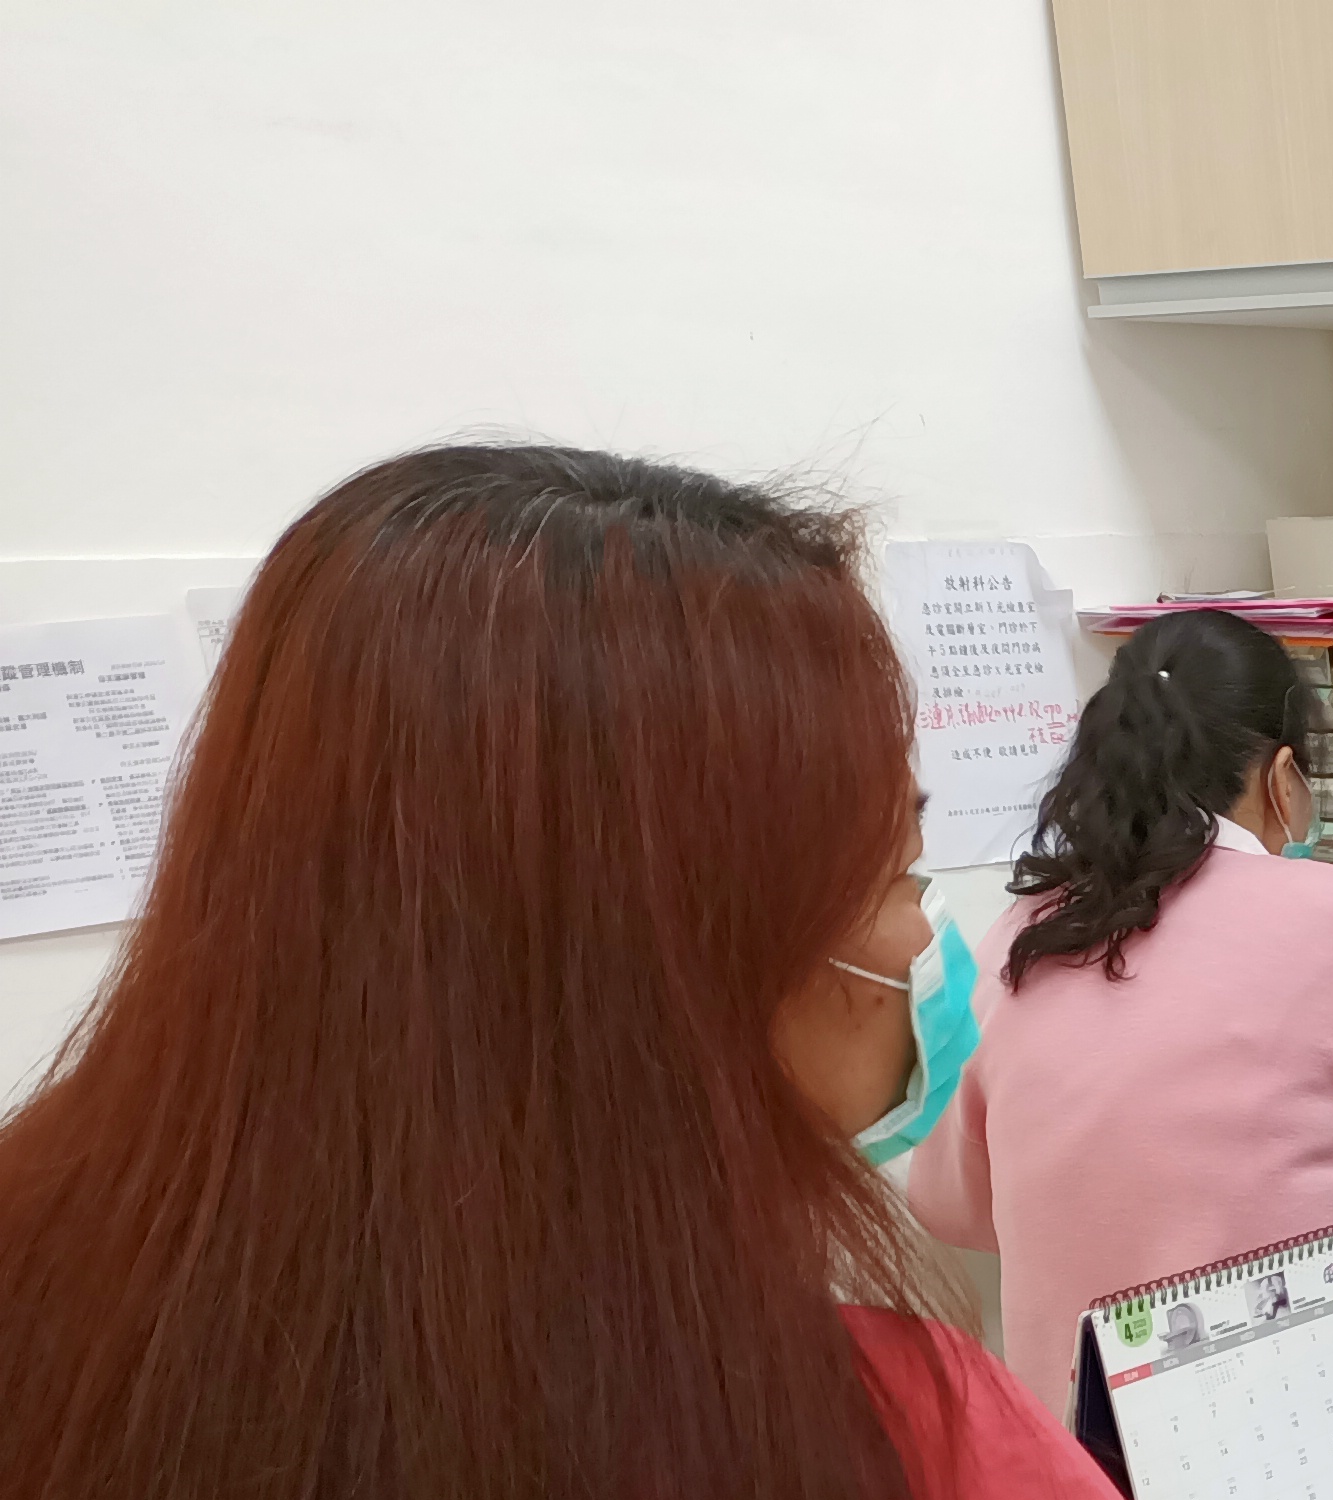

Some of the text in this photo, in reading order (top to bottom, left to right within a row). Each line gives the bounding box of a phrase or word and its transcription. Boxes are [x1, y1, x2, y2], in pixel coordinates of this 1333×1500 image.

[944, 574, 1013, 592] 放射科公告
[1124, 1323, 1134, 1342] 4
